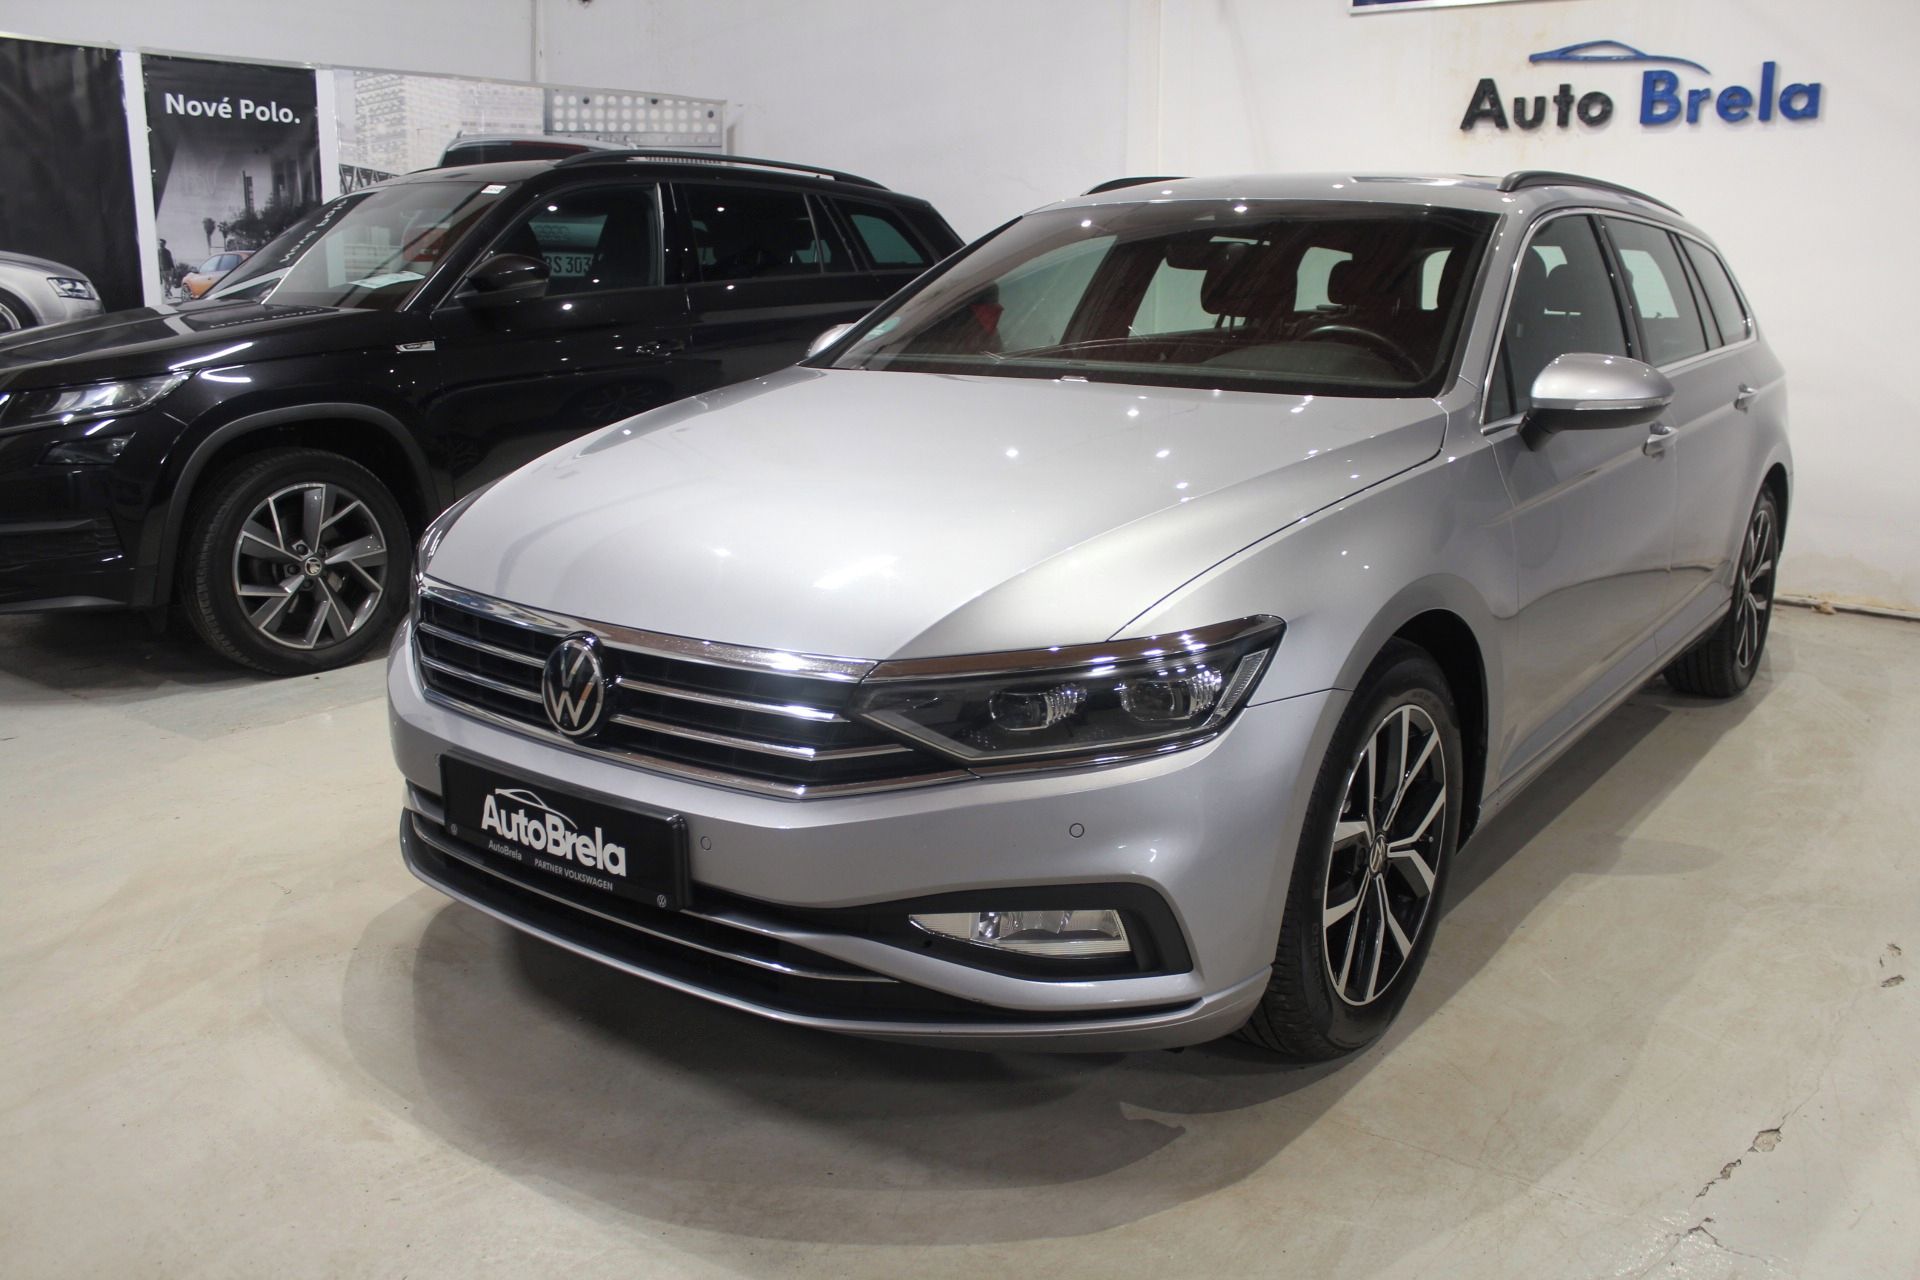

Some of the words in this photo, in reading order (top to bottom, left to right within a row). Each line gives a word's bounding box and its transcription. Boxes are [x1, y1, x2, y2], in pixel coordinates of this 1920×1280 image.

[164, 92, 233, 119] Nové
[239, 98, 301, 124] Polo.
[1460, 77, 1615, 131] Auto
[1638, 60, 1822, 126] Brela
[481, 794, 627, 877] AutoBrela
[488, 838, 523, 862] AutoBrela
[534, 857, 563, 876] PARTNER
[563, 867, 613, 893] VOLKSWAGEN
